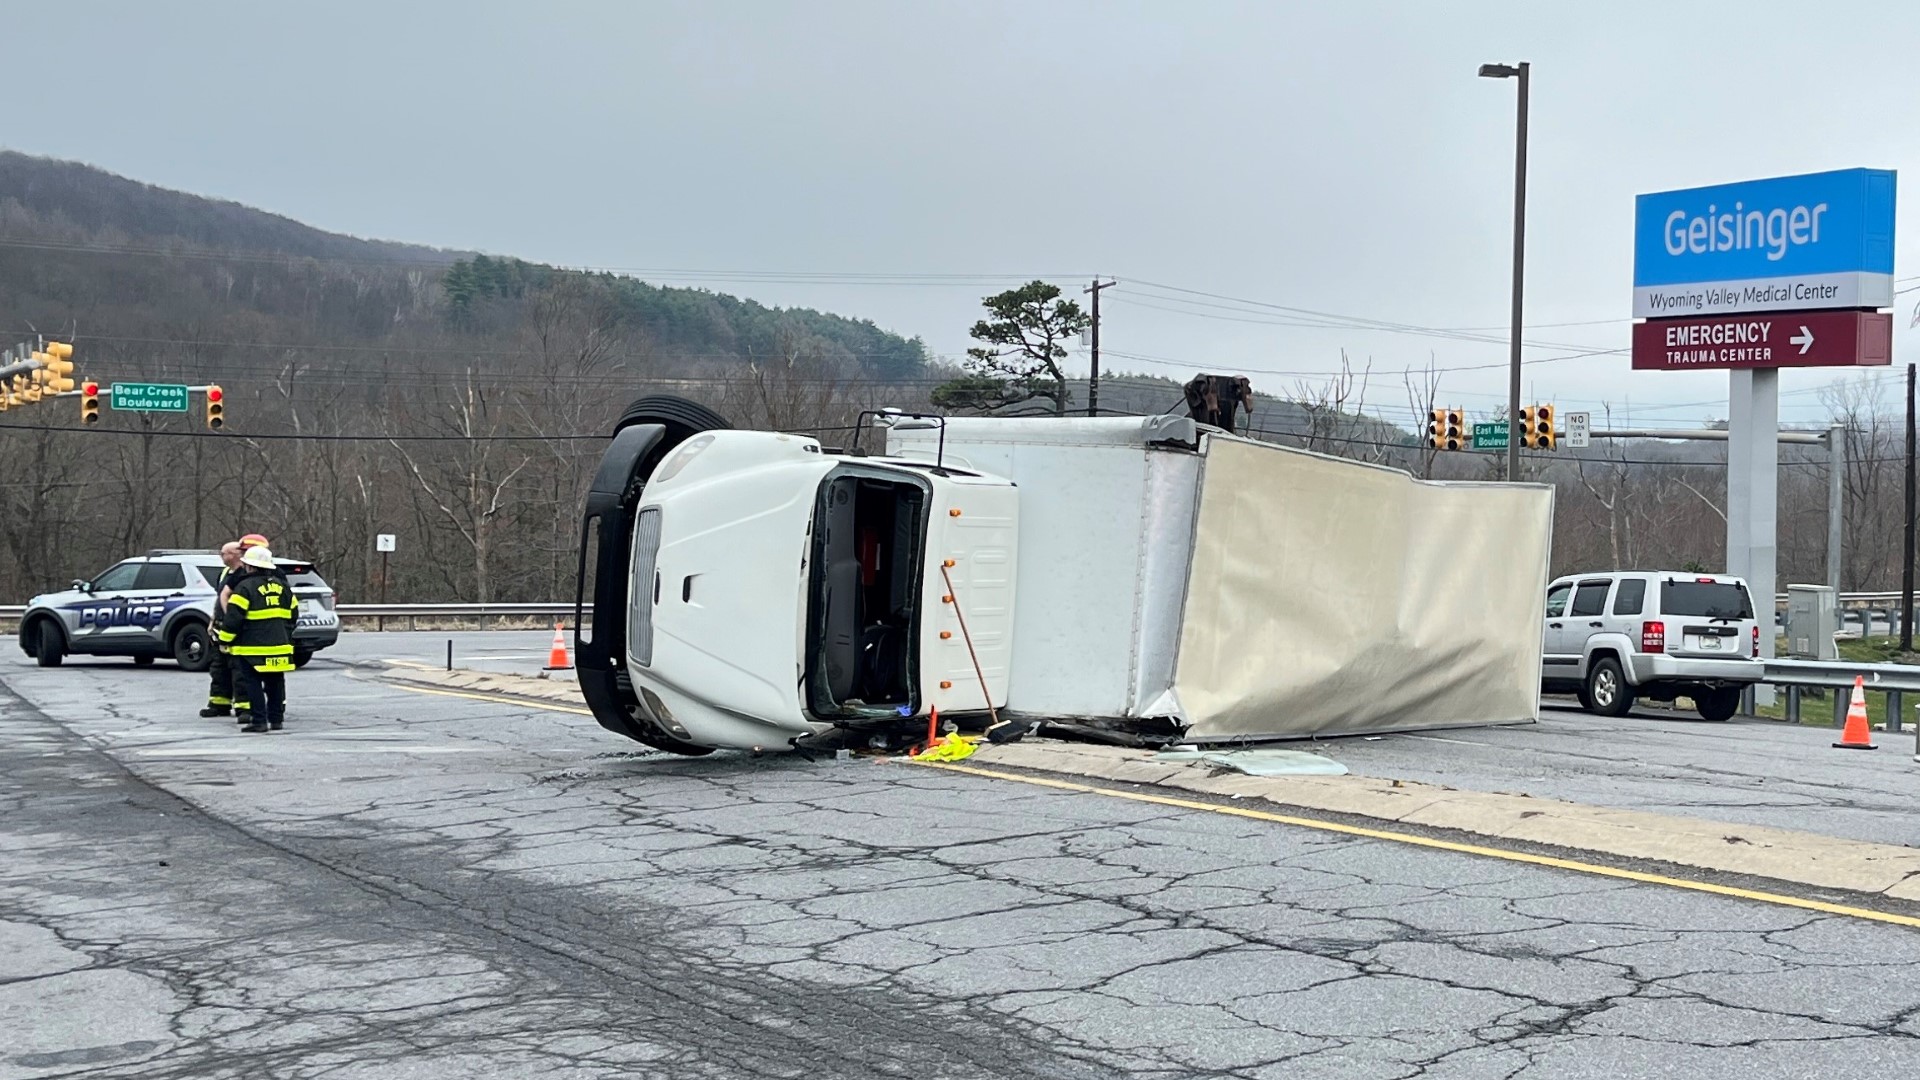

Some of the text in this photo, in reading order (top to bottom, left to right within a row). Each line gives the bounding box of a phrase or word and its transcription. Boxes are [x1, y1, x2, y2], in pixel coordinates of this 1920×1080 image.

[1664, 201, 1828, 261] Geisinger
[1650, 283, 1838, 311] Wyoming Valley Medical Center
[1666, 322, 1772, 347] EMERGENCY
[1666, 348, 1772, 364] TRAUMA CENTER
[115, 385, 184, 397] Bear Creek
[118, 397, 181, 408] Boulevard
[1571, 415, 1584, 424] NO
[1476, 425, 1509, 435] East Mou
[1479, 437, 1509, 446] Boulevar
[80, 606, 165, 627] POLICE
